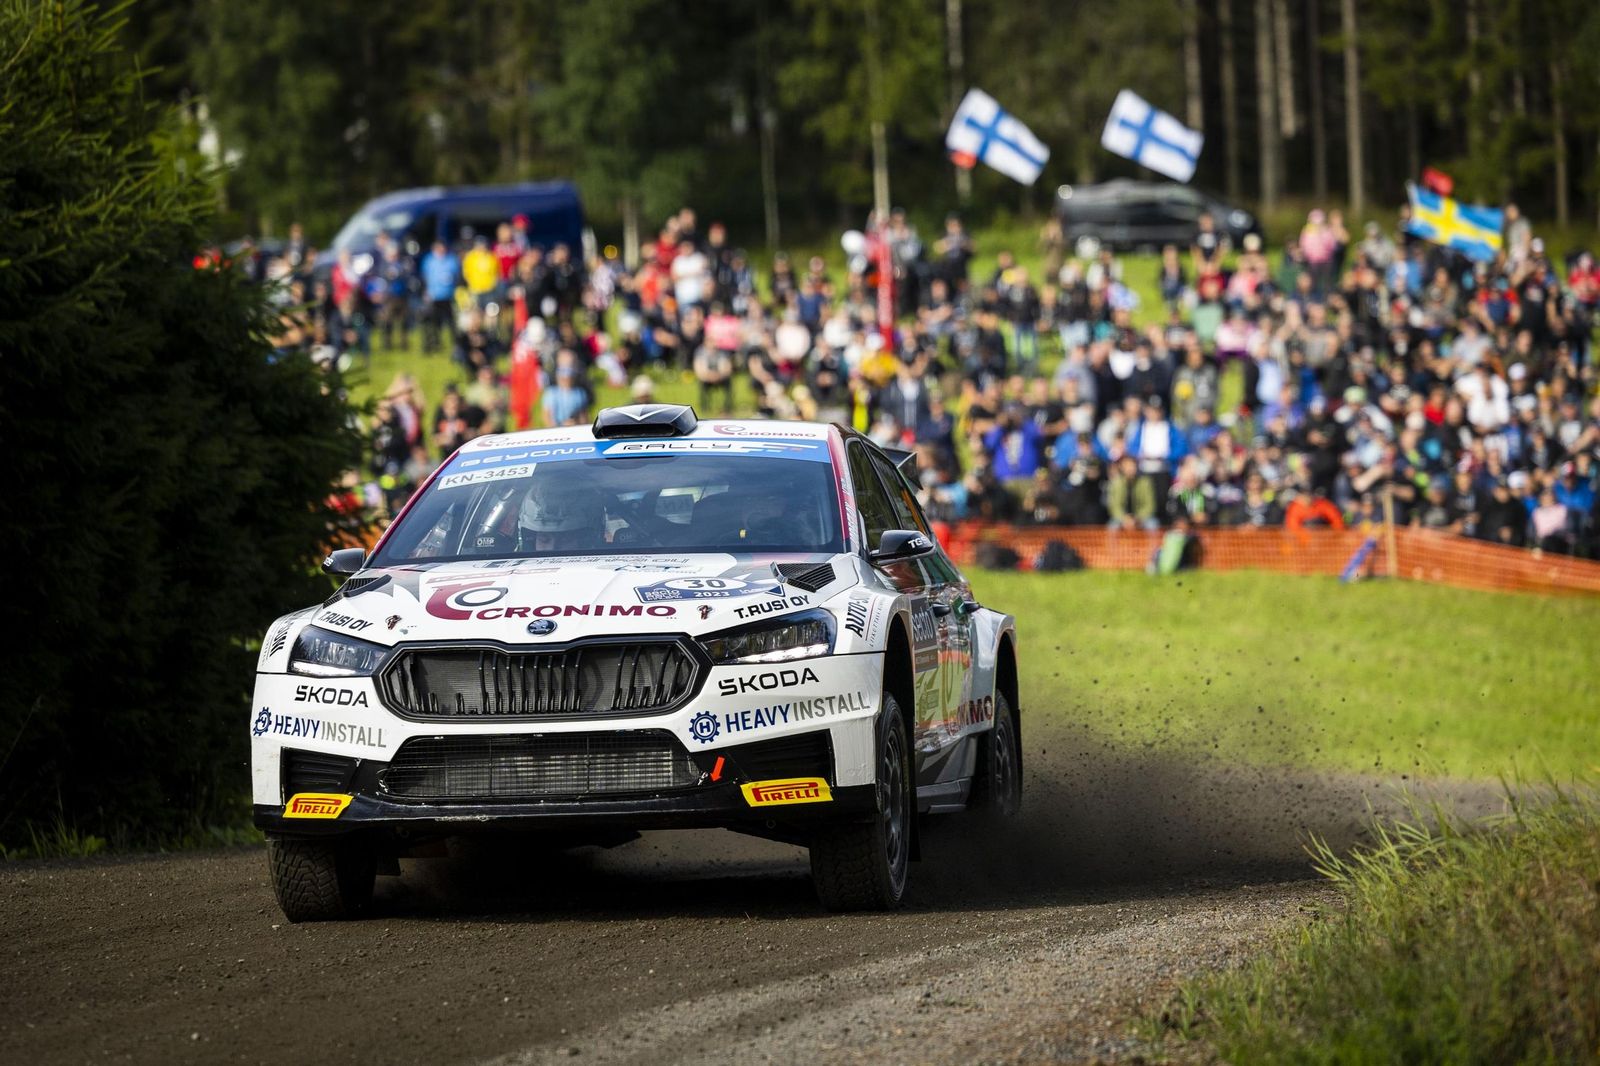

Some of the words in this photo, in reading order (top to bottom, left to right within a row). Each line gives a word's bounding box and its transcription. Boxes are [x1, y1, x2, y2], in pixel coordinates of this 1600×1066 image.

[460, 446, 595, 467] BEYOND
[623, 443, 732, 452] RALLY
[444, 467, 529, 486] KN-3453
[683, 579, 727, 589] 30
[476, 604, 677, 620] CRONIMO
[734, 599, 789, 620] T.RUSI
[789, 594, 811, 607] OY
[318, 611, 351, 629] T.RUSI
[349, 619, 374, 632] OY
[751, 781, 820, 803] PIRELLI
[291, 797, 342, 815] PIRELLI
